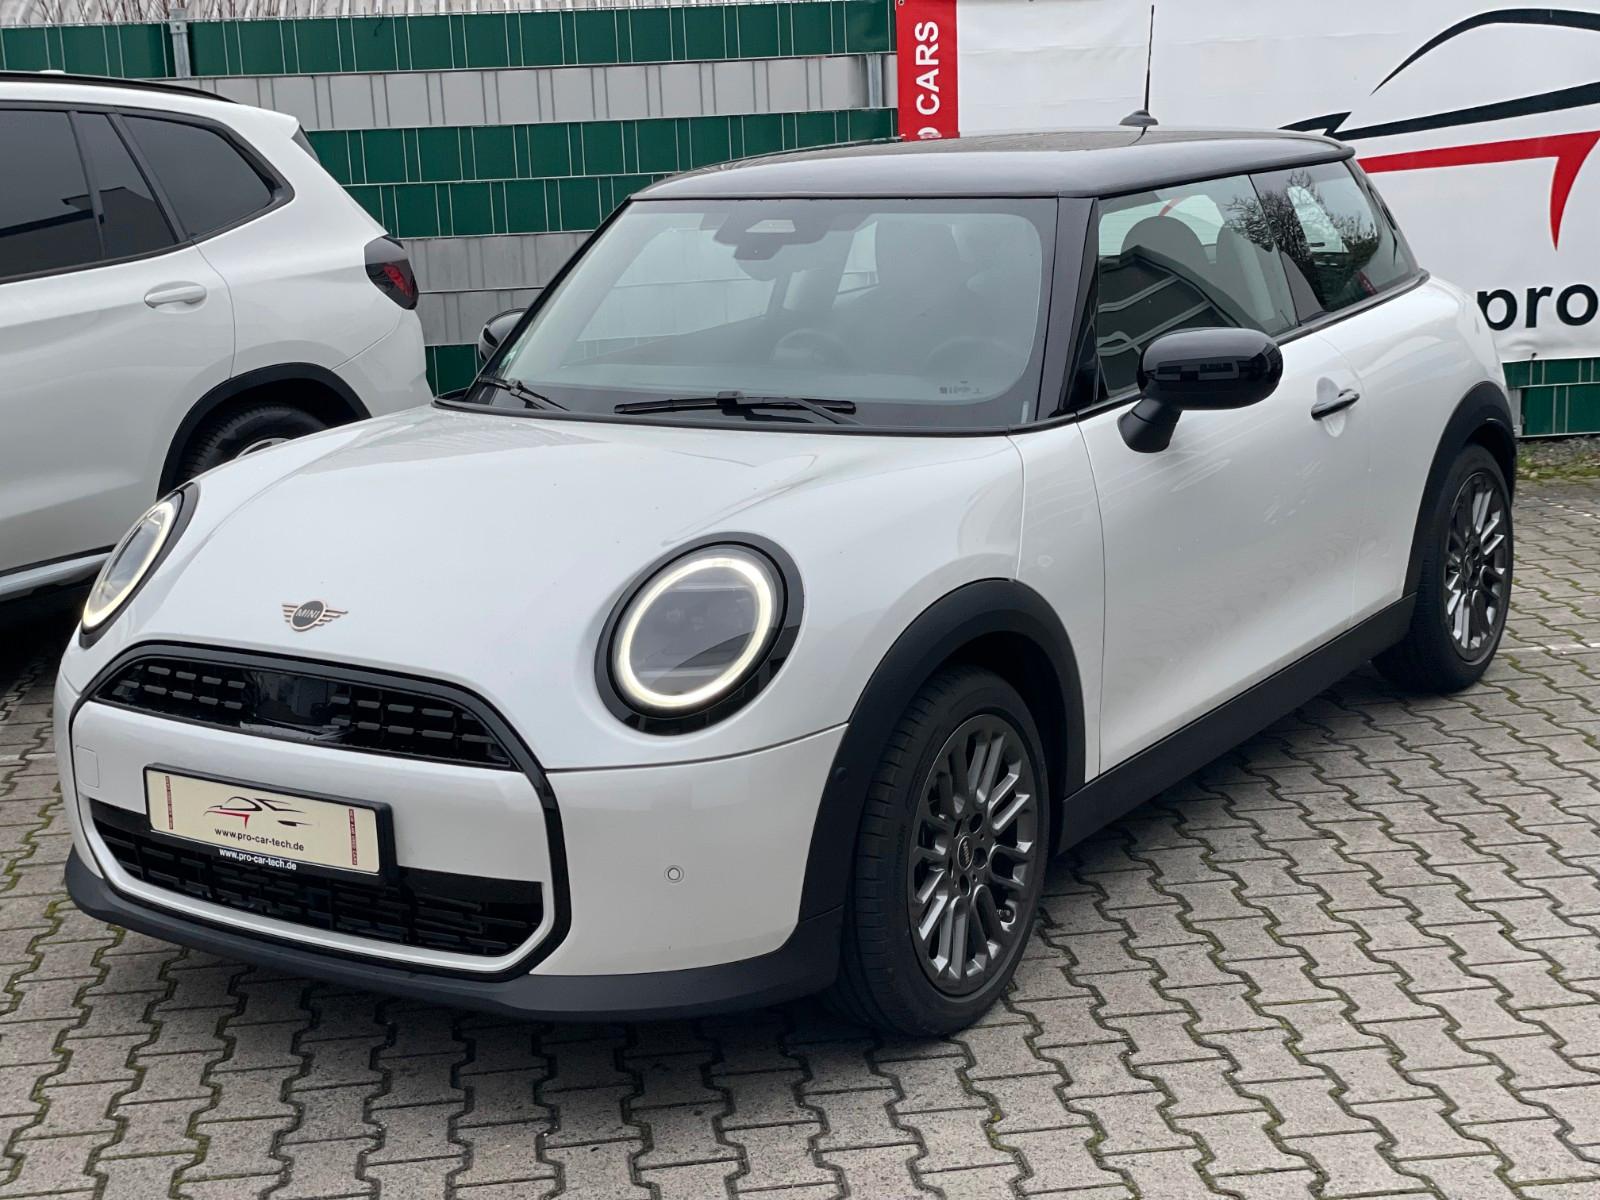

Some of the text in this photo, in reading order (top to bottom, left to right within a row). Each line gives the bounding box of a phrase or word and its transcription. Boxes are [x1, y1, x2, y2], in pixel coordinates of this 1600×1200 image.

[914, 21, 940, 116] CARS
[295, 608, 320, 619] MINI
[214, 828, 305, 851] www.pro-car-tech.de
[219, 848, 297, 870] www.pro-car-tech.de
